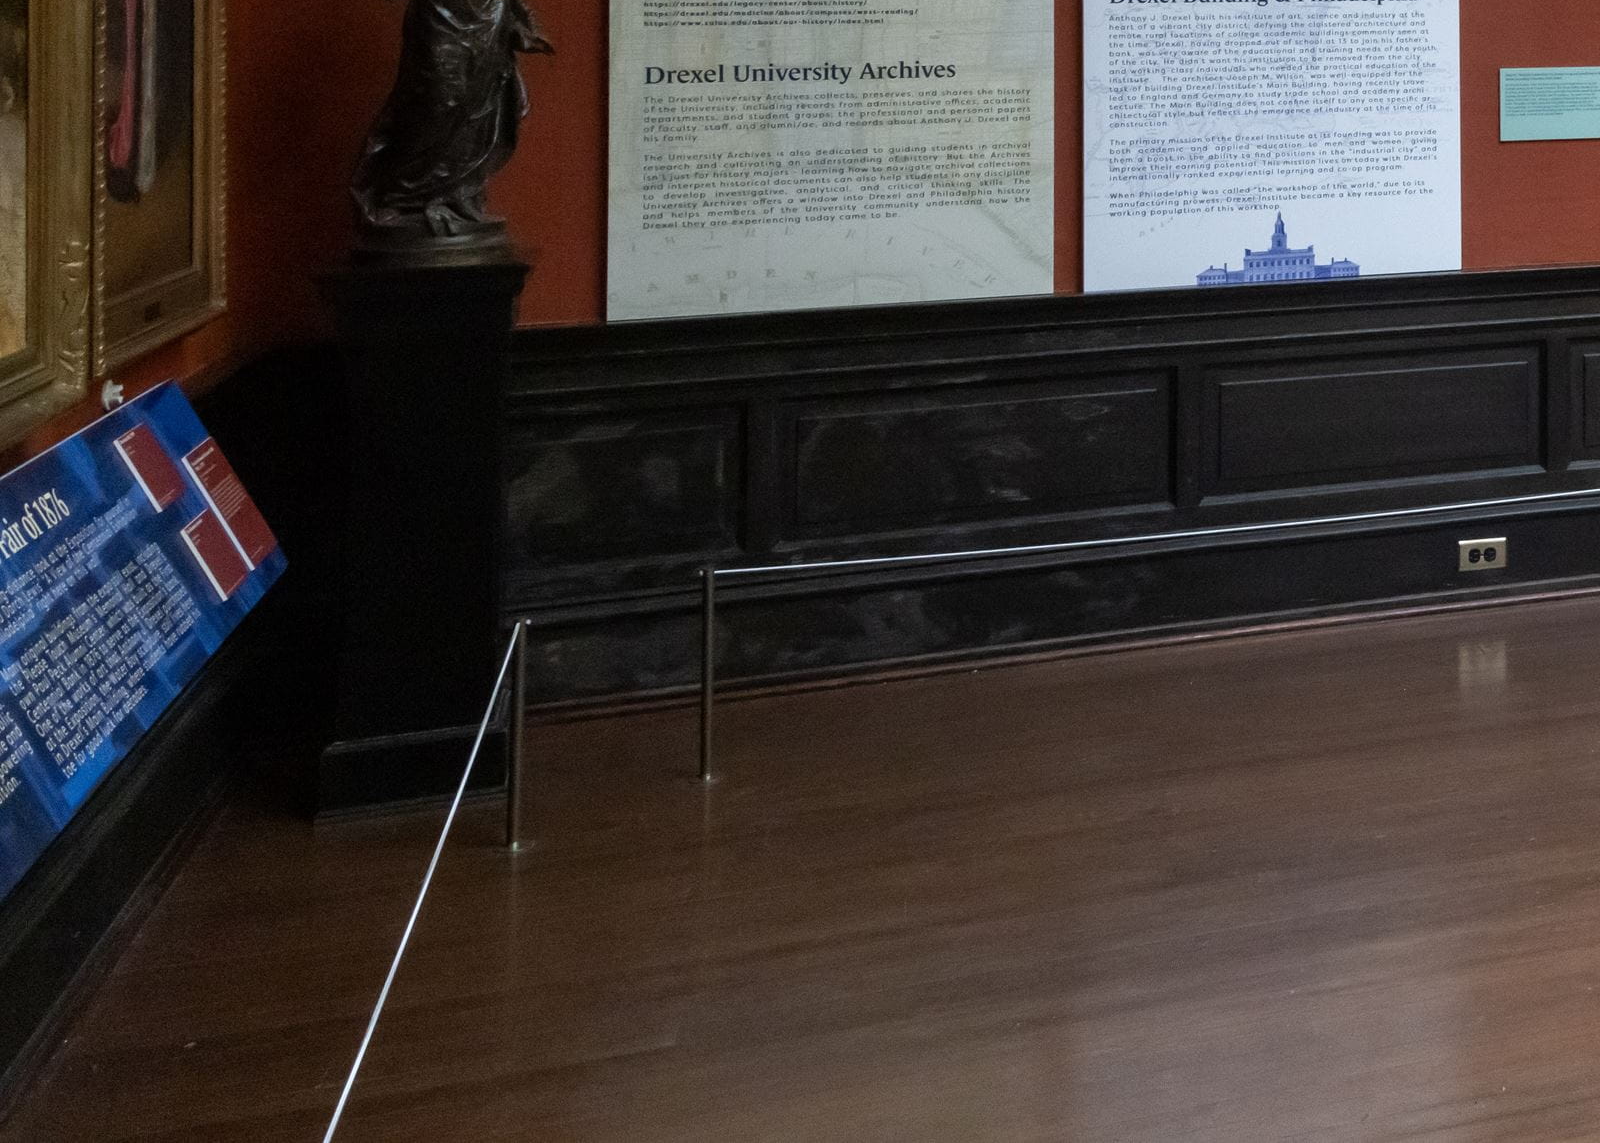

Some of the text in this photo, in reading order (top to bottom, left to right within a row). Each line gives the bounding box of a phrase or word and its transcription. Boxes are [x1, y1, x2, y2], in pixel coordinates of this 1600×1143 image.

[644, 60, 956, 85] Drexel University Archives
[22, 503, 44, 540] of
[32, 488, 70, 529] 1876
